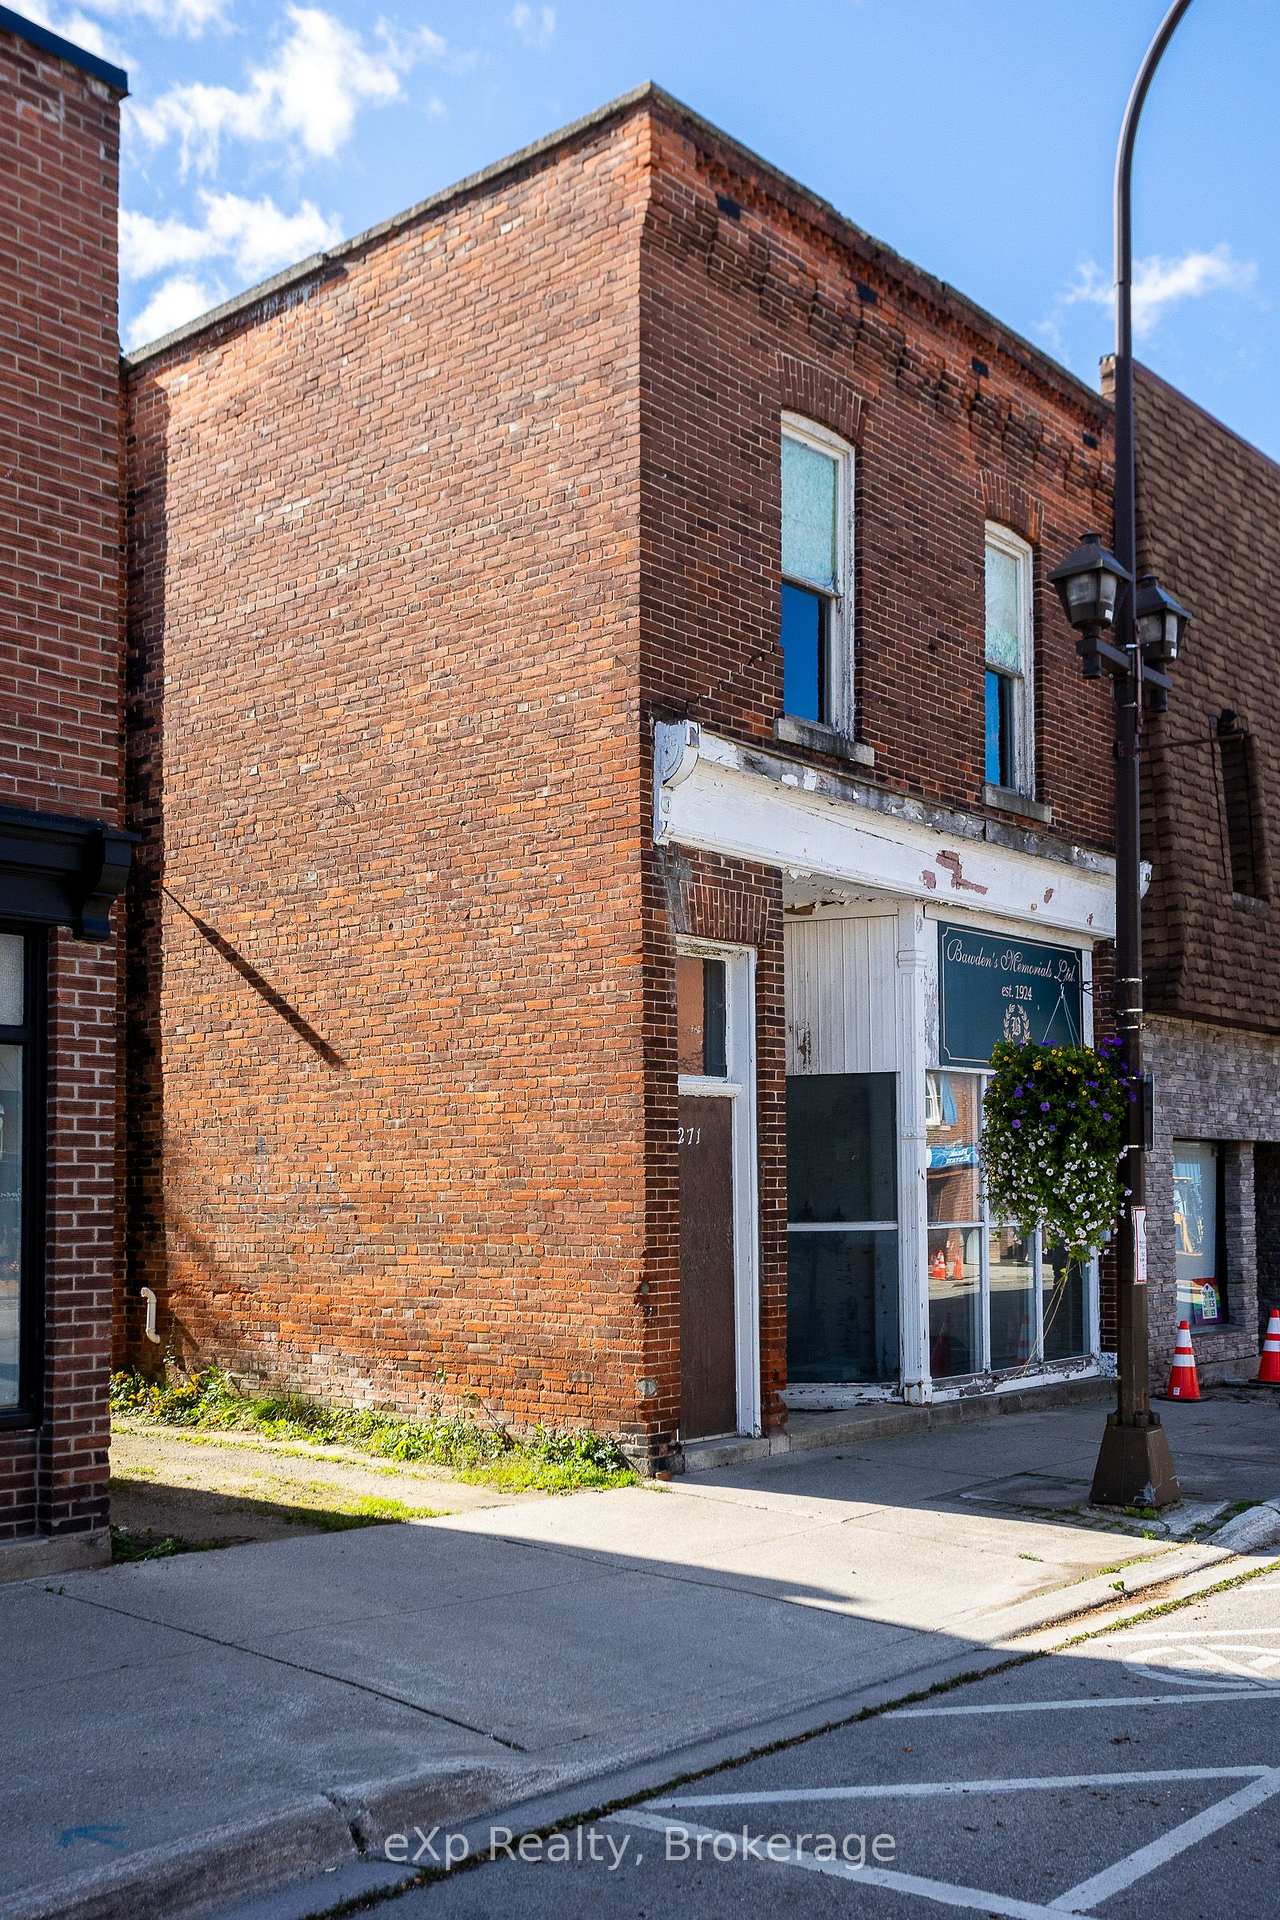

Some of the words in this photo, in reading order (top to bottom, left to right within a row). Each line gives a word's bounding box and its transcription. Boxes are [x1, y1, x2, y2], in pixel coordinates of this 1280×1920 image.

[947, 939, 998, 968] Bawden's
[1001, 950, 1052, 978] Memorials
[1054, 960, 1076, 982] Ltd.
[1001, 985, 1014, 998] est.
[1015, 986, 1032, 1000] 1924
[677, 1127, 701, 1145] 271
